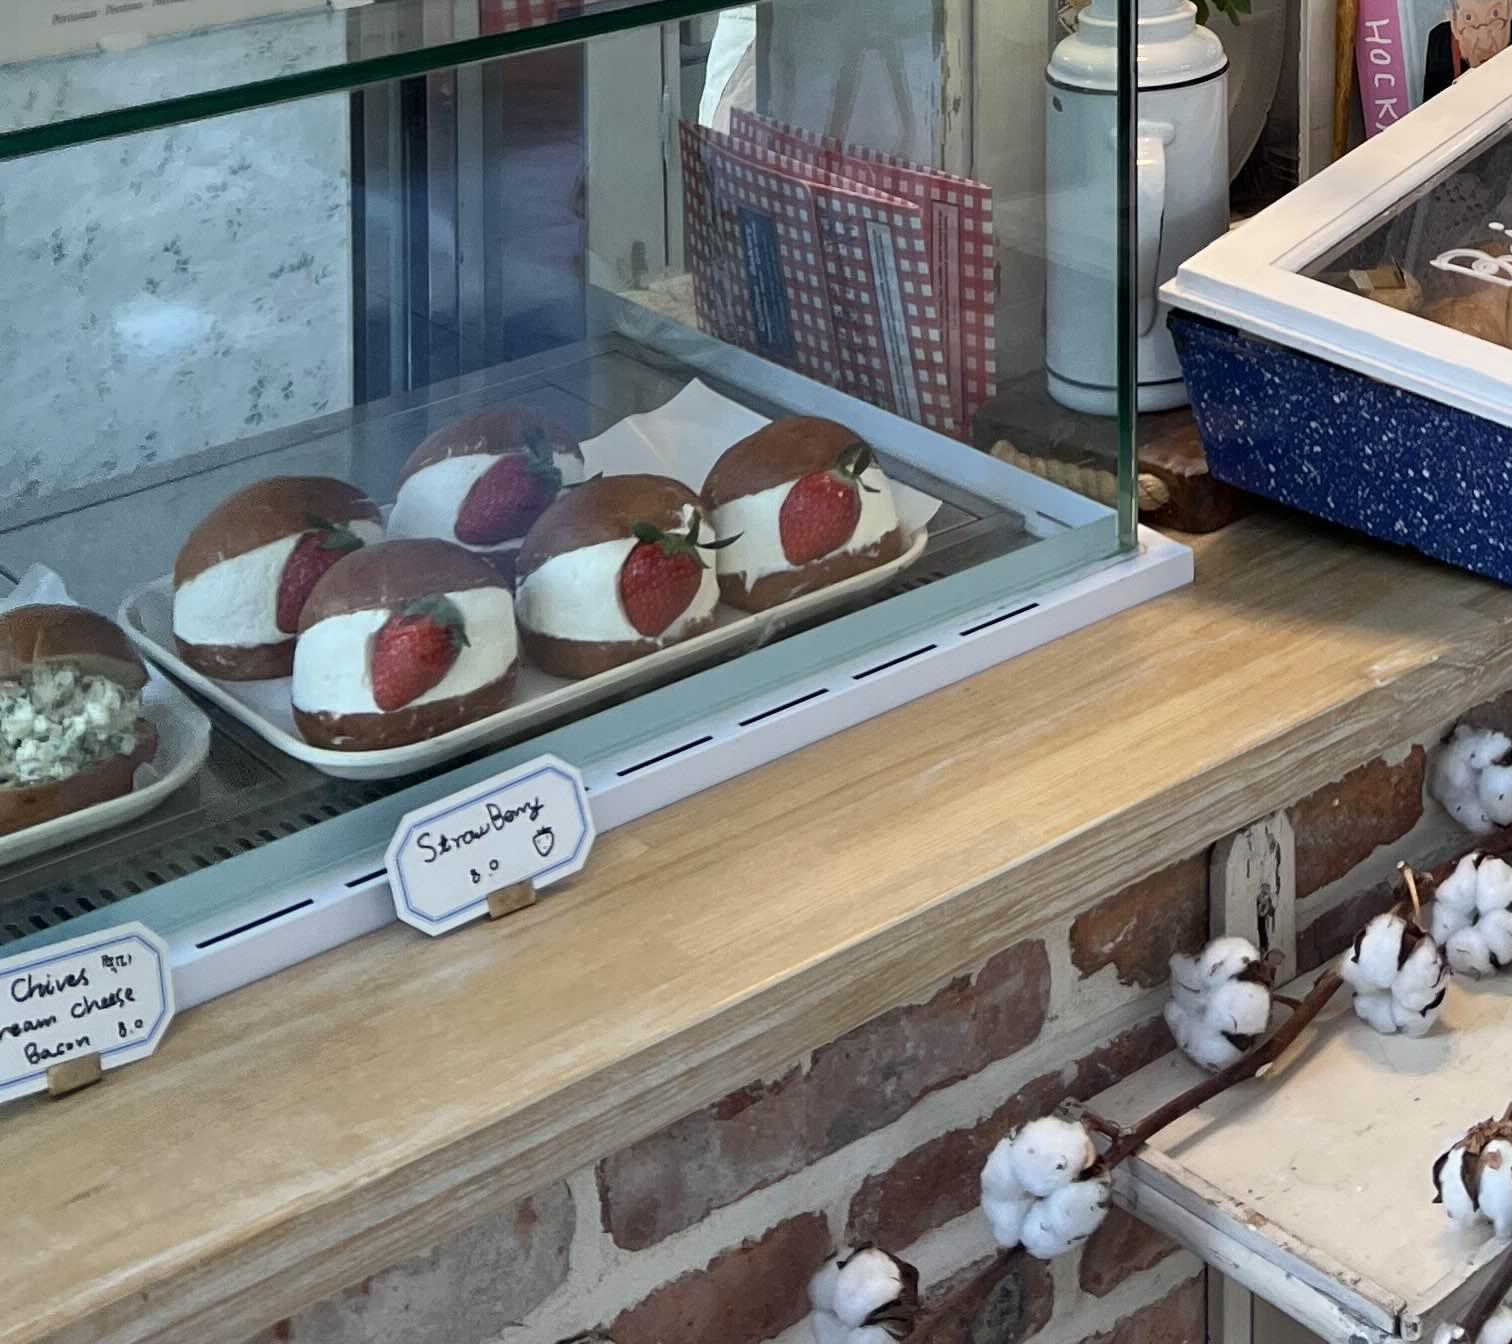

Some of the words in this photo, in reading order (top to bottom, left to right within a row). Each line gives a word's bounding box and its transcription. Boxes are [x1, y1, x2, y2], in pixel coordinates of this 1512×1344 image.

[1364, 18, 1400, 132] HOCK
[11, 967, 89, 1003] Chives
[0, 1015, 57, 1041] ream
[23, 1035, 91, 1065] Bacon
